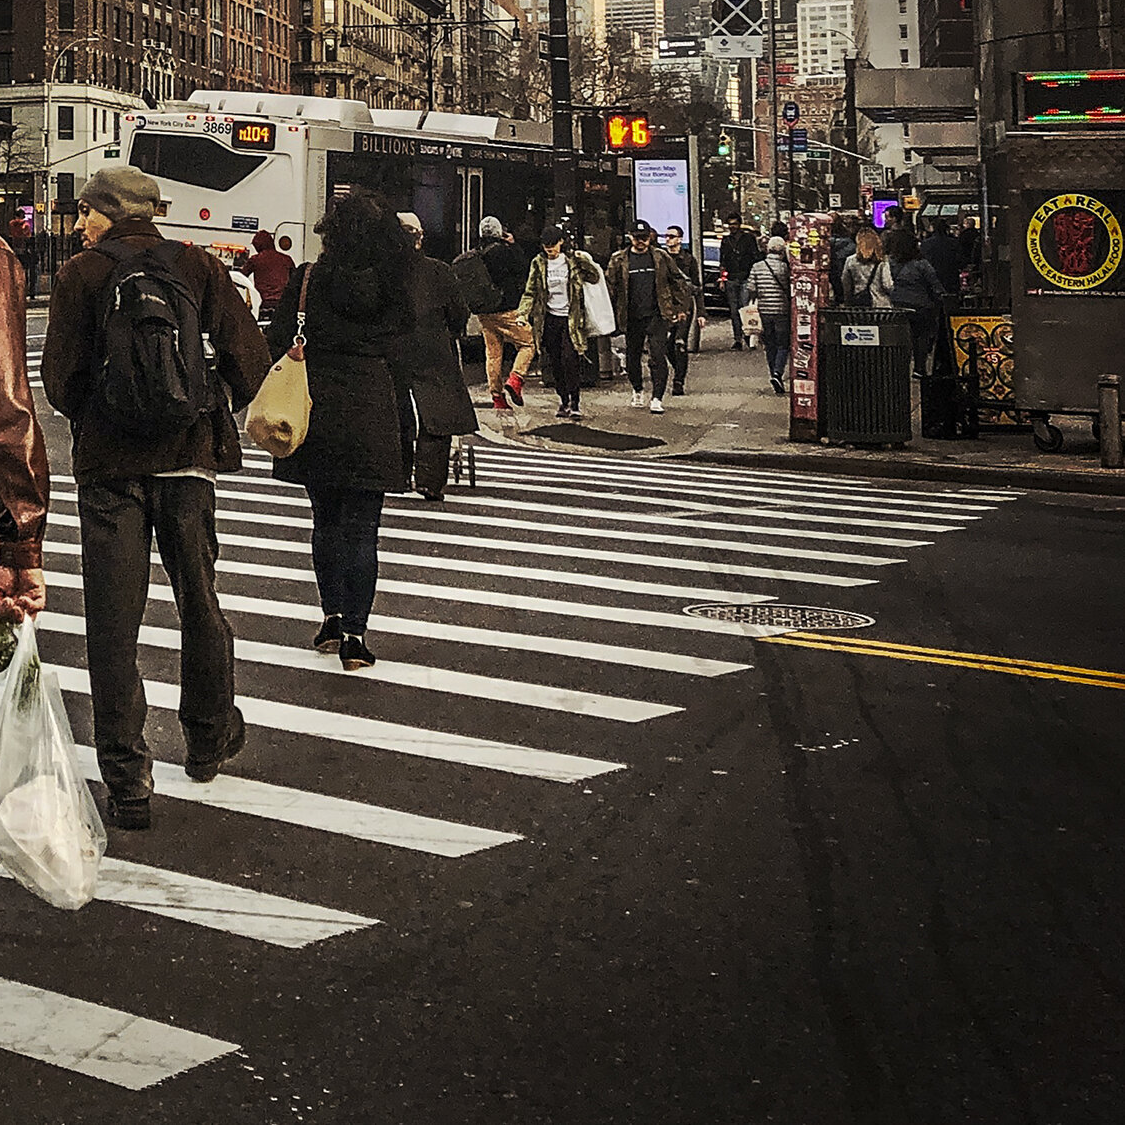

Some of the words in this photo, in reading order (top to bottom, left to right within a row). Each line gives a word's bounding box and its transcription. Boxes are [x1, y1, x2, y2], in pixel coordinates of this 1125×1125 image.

[172, 120, 184, 128] City
[203, 122, 232, 134] 3869
[362, 134, 416, 156] BILLIONS
[1035, 199, 1059, 223] EAT
[1075, 196, 1113, 224] REAL
[1029, 237, 1048, 272] MIDDLE
[1046, 268, 1086, 288] EASTERN
[1086, 265, 1114, 285] HALAL
[1109, 238, 1121, 265] FOOD
